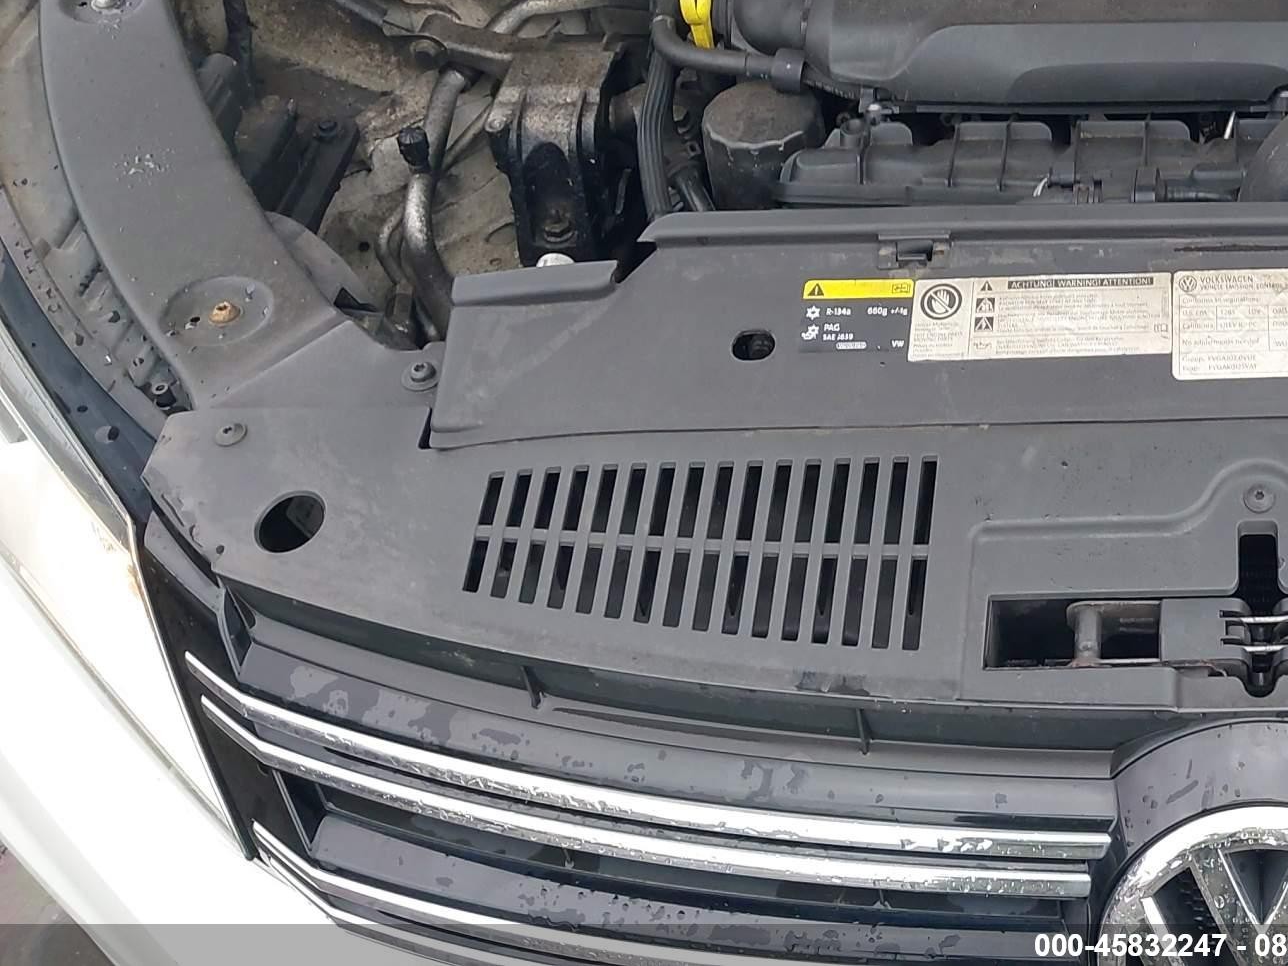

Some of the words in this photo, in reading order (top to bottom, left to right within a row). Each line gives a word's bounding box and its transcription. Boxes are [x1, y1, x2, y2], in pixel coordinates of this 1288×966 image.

[1011, 281, 1055, 289] ACHTUNG!
[1057, 279, 1101, 288] WARNING!
[1102, 277, 1152, 286] ATTENTION!
[1199, 275, 1254, 284] VOLKSWAGEN
[826, 307, 852, 316] R-134a
[823, 323, 841, 332] PAG
[822, 333, 836, 341] SAE
[891, 340, 905, 348] VW
